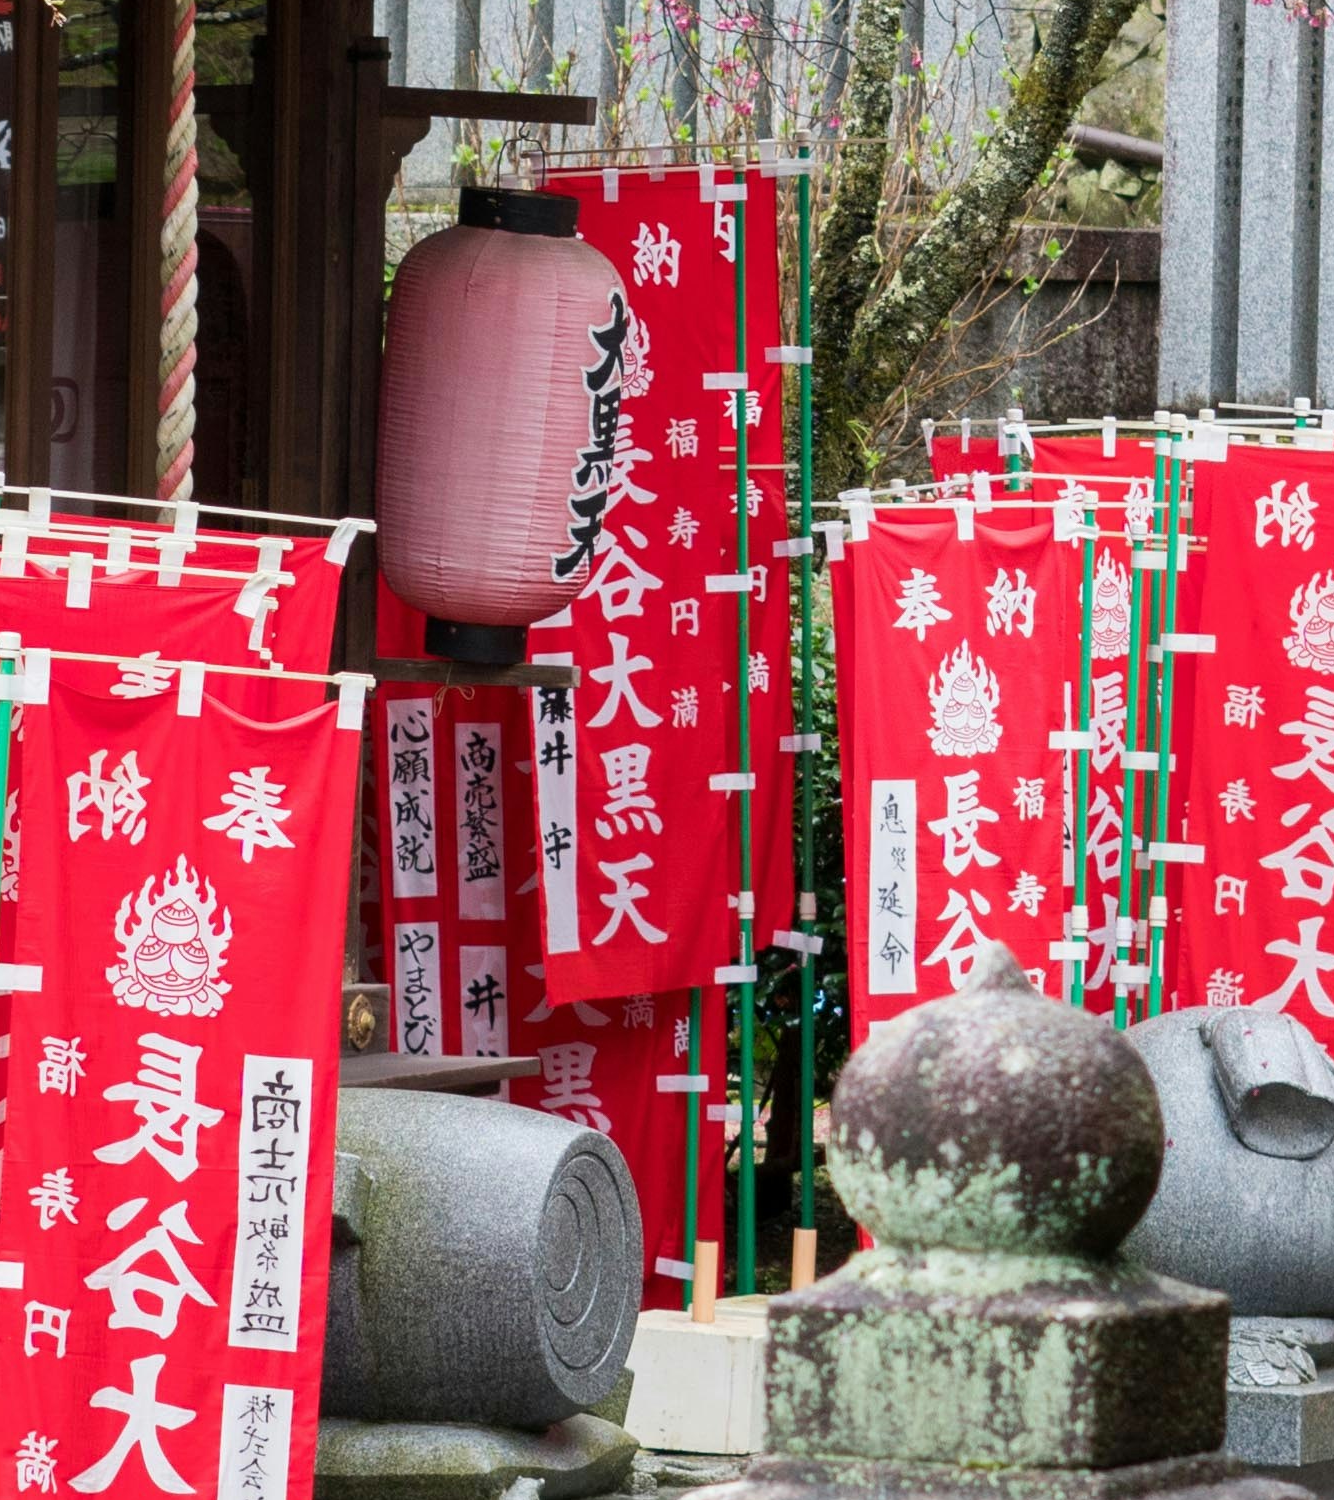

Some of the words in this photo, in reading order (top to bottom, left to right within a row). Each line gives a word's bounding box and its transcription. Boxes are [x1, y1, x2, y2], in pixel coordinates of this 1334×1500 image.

[664, 416, 701, 729] 福寿円満
[892, 566, 1038, 642] 奉納
[390, 708, 435, 876] 心願成就
[459, 730, 500, 884] 商売繁盛
[876, 793, 911, 976] 息災延命
[398, 928, 438, 1057] やまとび
